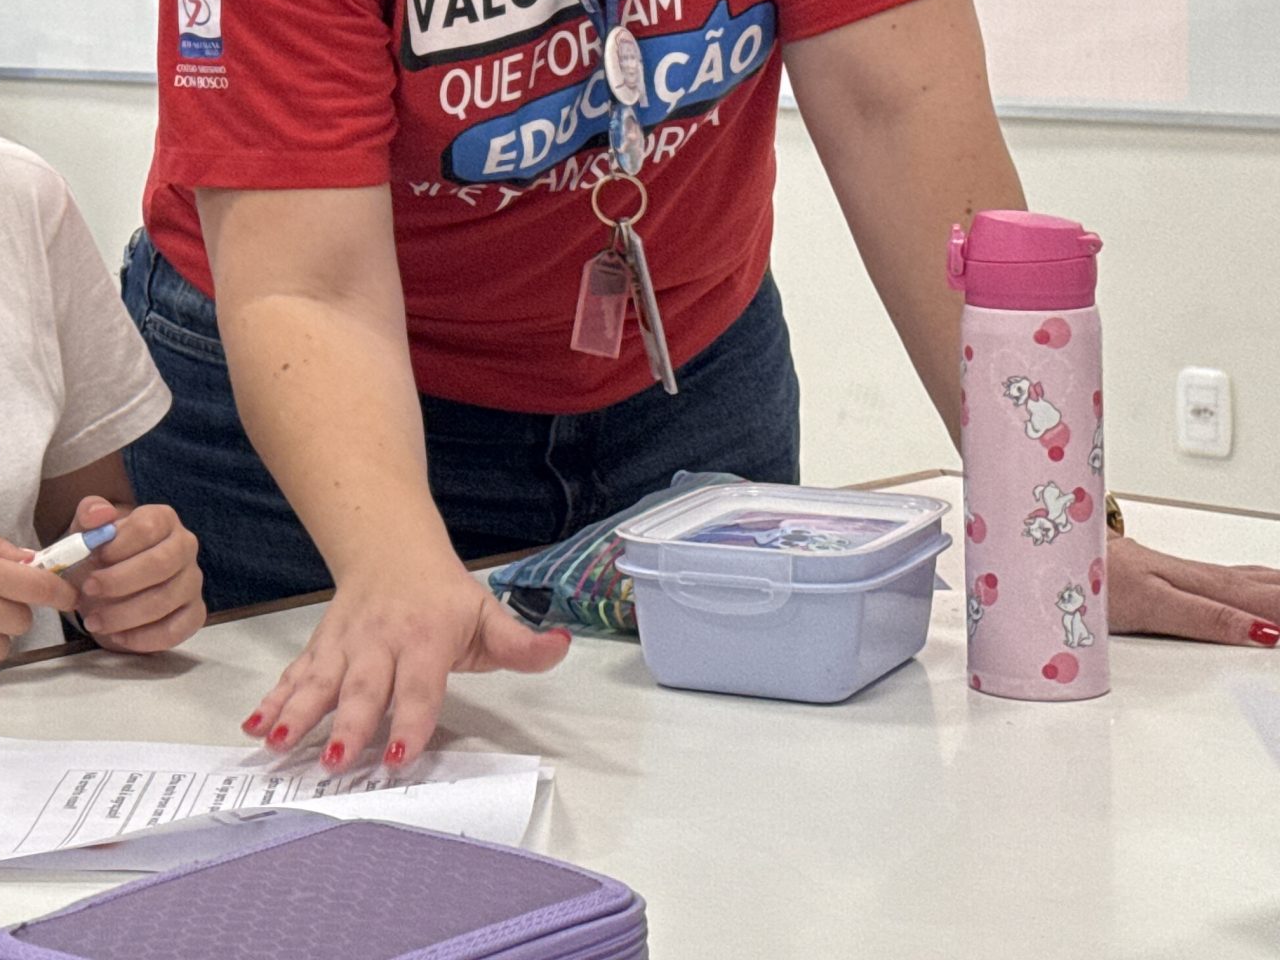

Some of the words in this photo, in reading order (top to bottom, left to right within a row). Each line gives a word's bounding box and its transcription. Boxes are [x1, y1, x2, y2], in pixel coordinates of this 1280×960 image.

[197, 76, 229, 89] BOSCO
[439, 53, 523, 120] QUE
[482, 24, 763, 175] EDUCÇÃO
